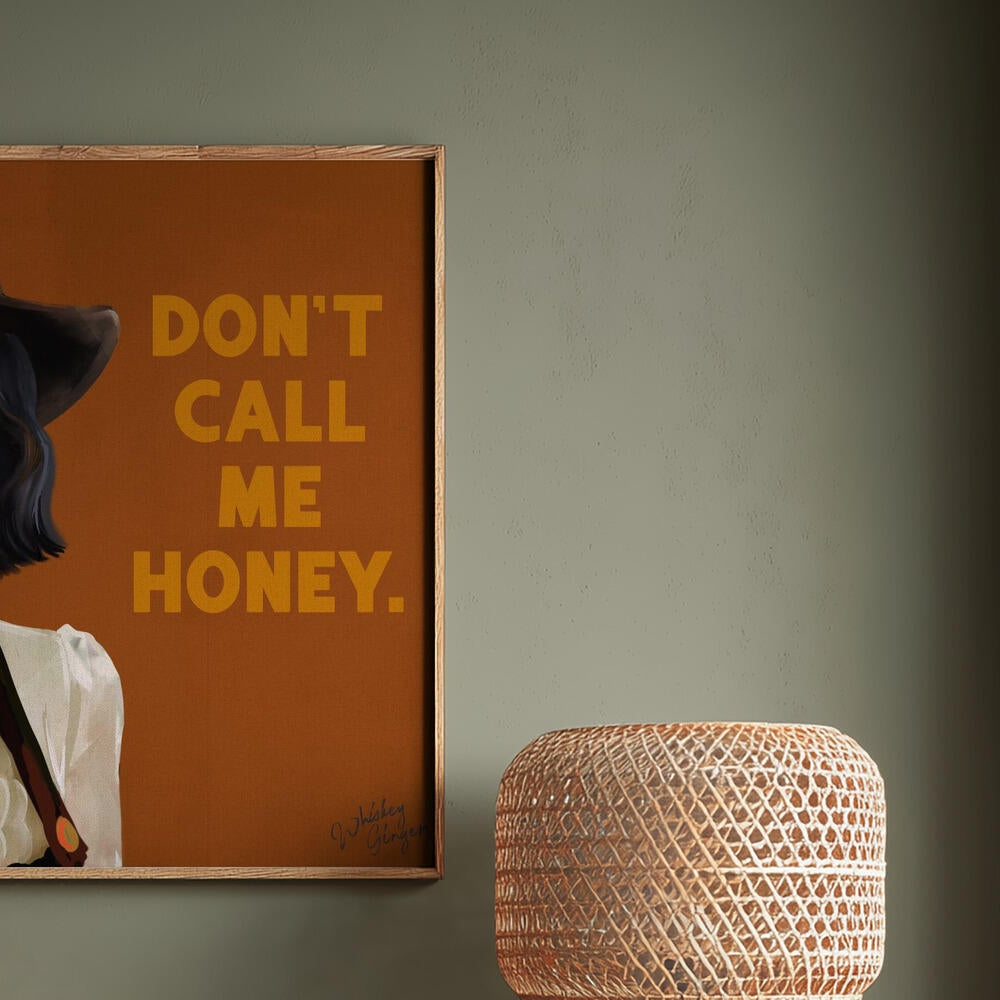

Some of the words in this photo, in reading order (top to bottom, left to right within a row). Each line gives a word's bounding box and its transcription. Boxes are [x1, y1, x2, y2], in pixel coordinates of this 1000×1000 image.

[152, 293, 383, 358] DON'T
[174, 379, 366, 443] CALL
[218, 465, 321, 528] ME
[133, 549, 405, 614] HONEY.
